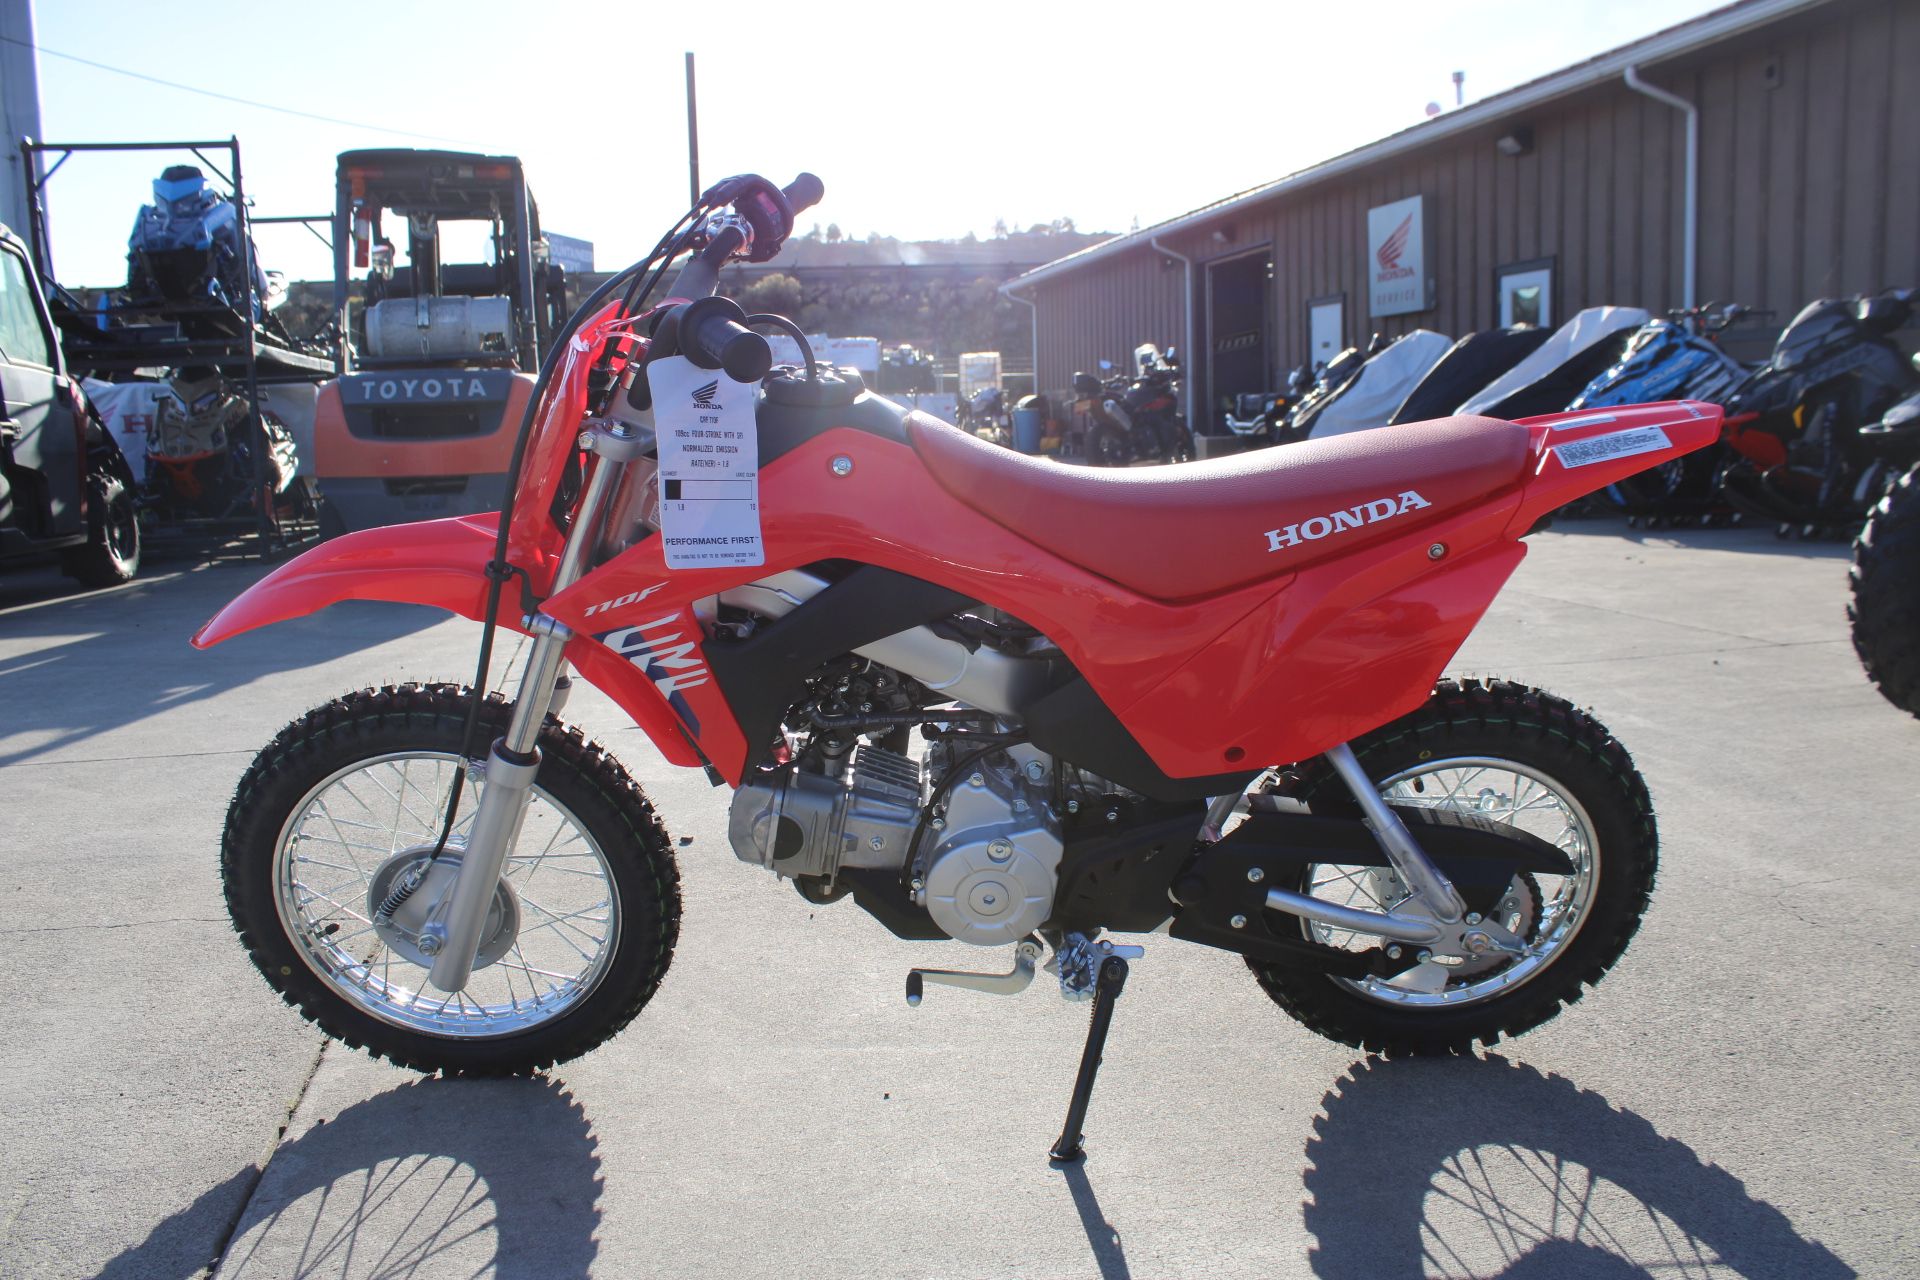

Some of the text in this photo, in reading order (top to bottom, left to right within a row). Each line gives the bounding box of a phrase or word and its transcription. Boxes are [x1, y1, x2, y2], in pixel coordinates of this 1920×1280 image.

[1376, 266, 1415, 282] HONDA
[362, 379, 487, 399] TOYOTA
[682, 445, 738, 454] NORMALIZED EMISSION
[1264, 490, 1432, 552] HONDA
[665, 537, 728, 546] PERFORMANCE
[583, 580, 671, 617] 110F
